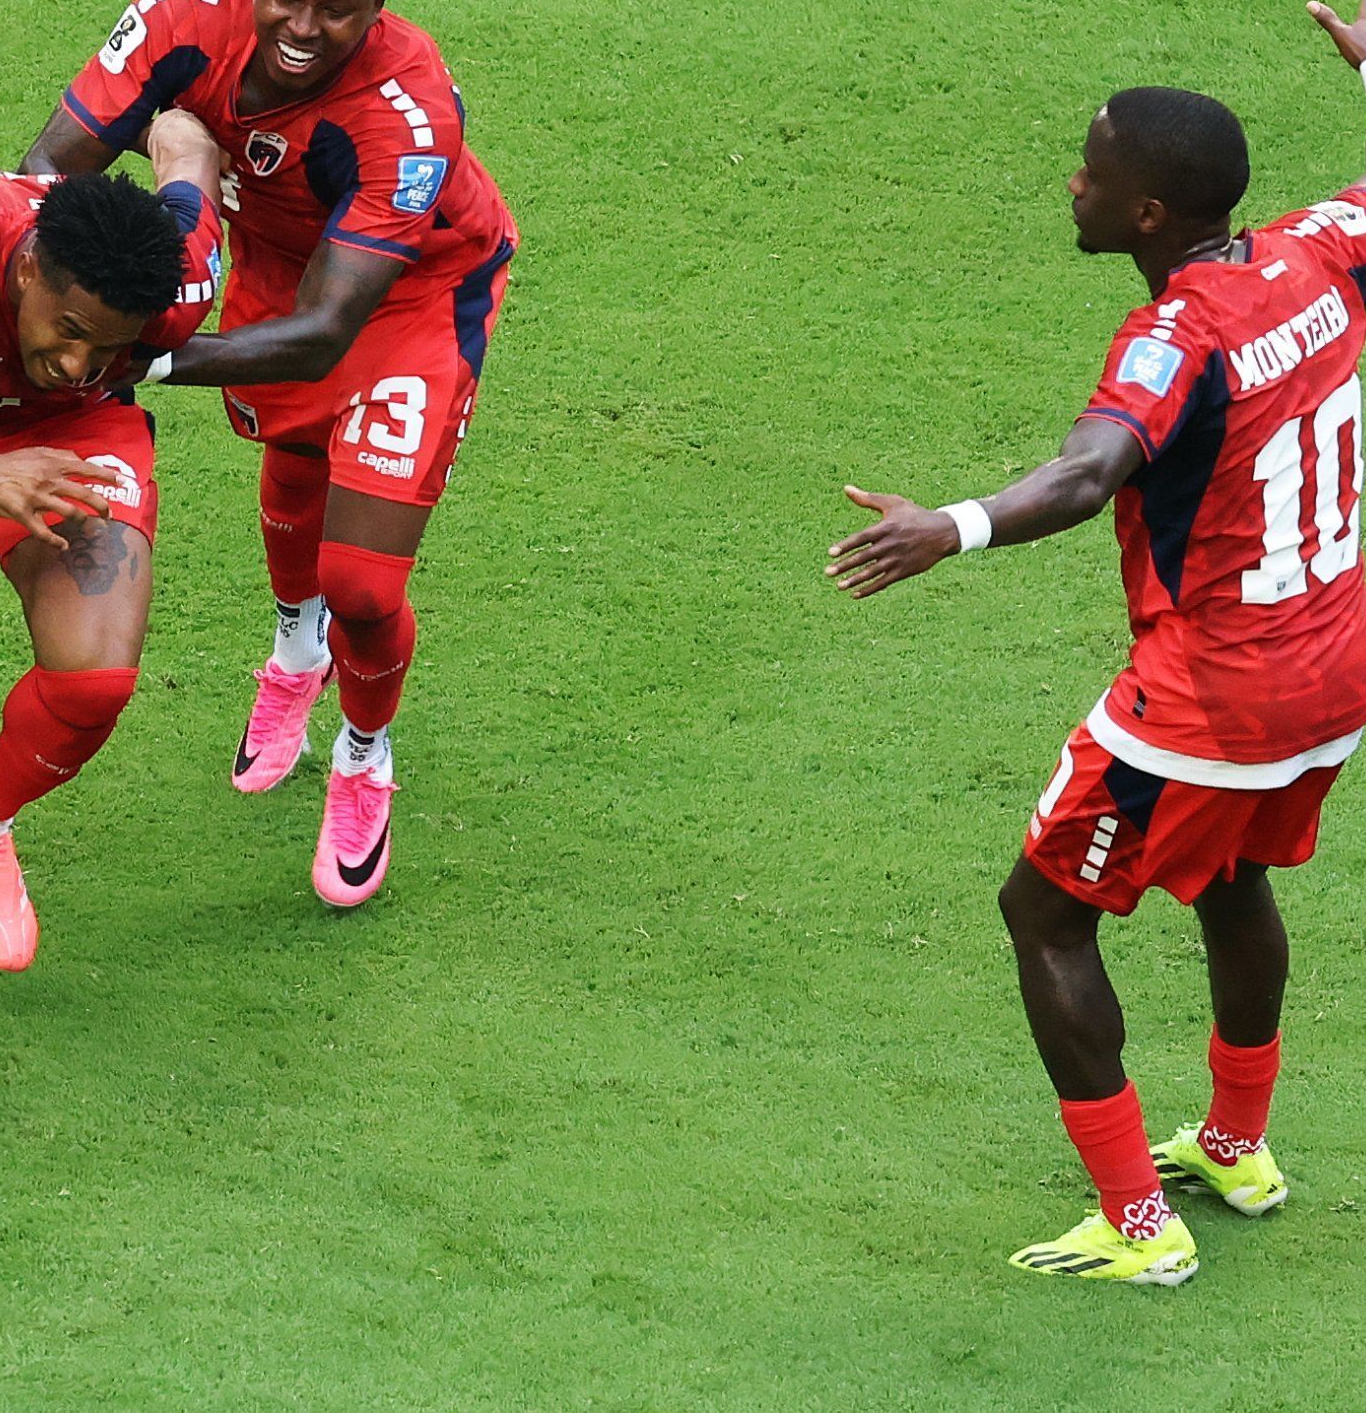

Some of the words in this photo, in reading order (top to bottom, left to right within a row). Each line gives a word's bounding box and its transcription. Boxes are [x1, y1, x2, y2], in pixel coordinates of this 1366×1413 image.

[343, 375, 427, 455] 13
[357, 451, 415, 476] capelli
[1241, 372, 1365, 605] 10
